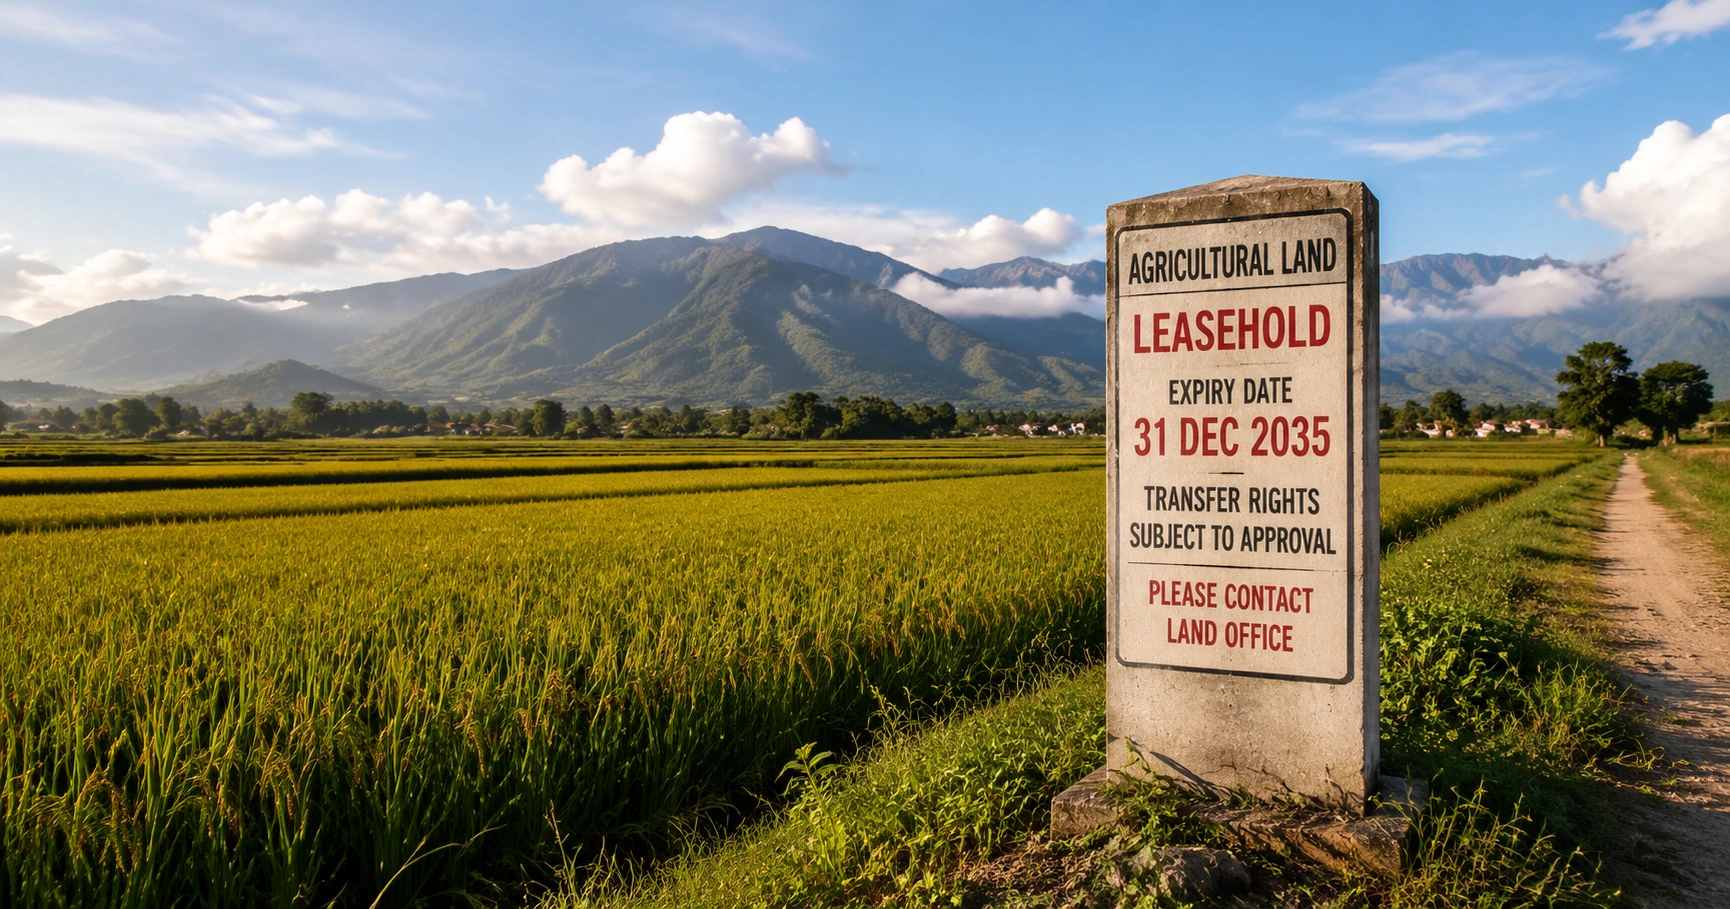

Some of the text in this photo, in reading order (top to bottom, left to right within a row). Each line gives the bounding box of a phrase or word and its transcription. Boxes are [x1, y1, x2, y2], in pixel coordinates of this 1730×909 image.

[1129, 237, 1337, 285] AGRICULTURAL LAND
[1134, 305, 1330, 353] LEASEHOLD
[1170, 377, 1292, 404] EXPIRY DATE
[1135, 416, 1330, 457] 31 DEC 2035
[1144, 486, 1319, 515] TRANSFER RIGHTS
[1130, 523, 1336, 554] SUBJECT TO APPROVAL
[1150, 580, 1313, 613] PLEASE CONTACT
[1168, 618, 1293, 652] LAND OFFICE
